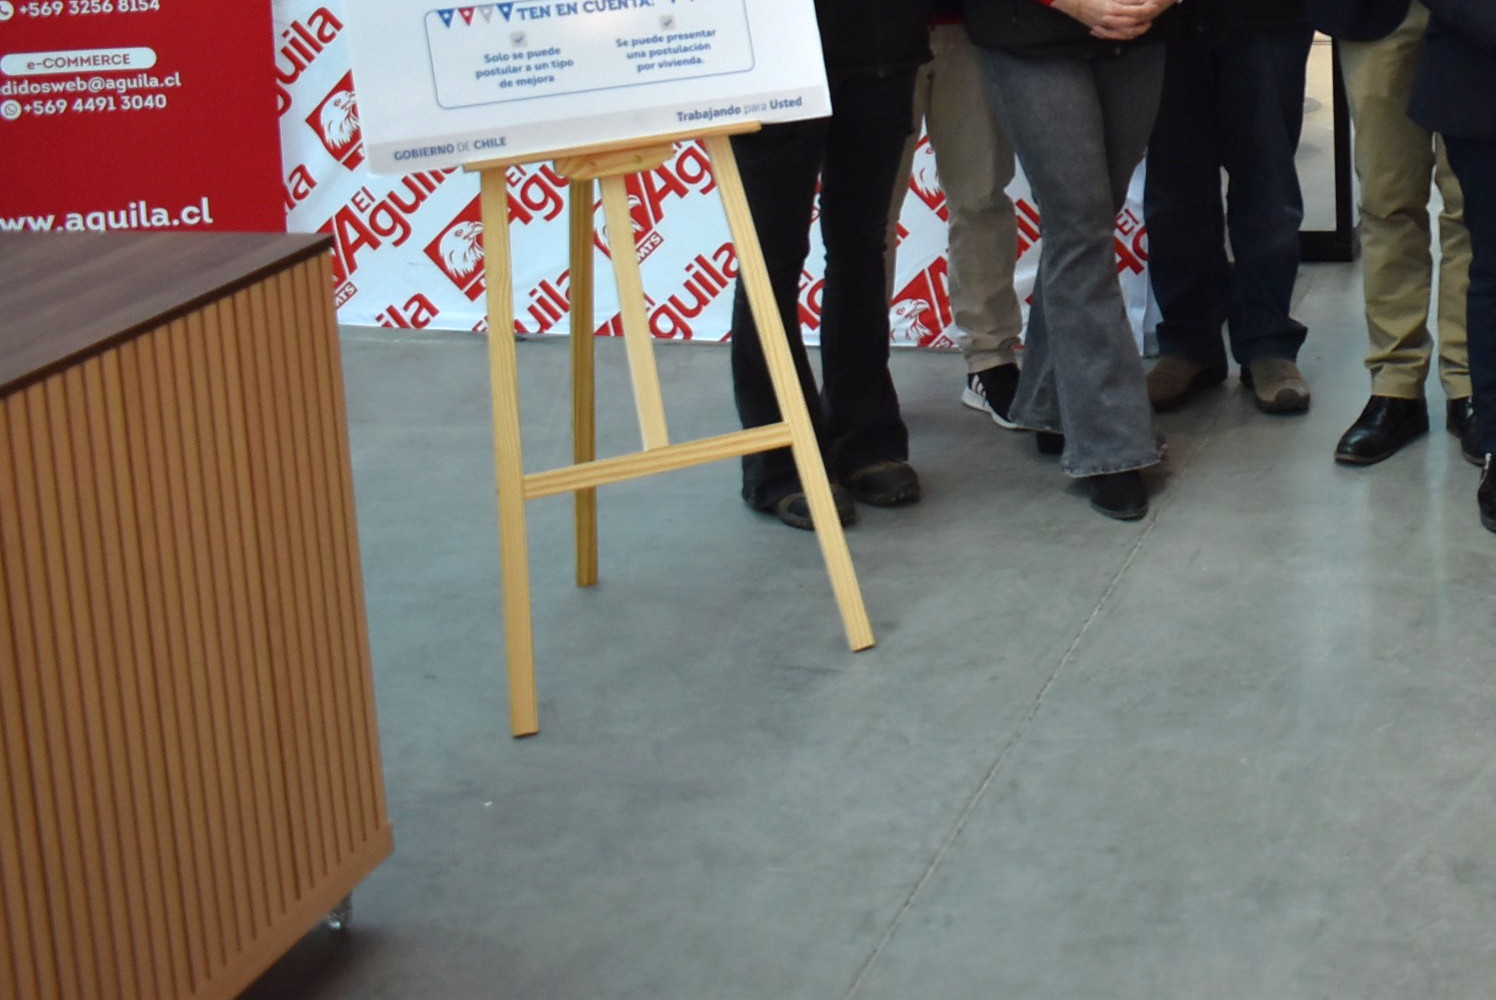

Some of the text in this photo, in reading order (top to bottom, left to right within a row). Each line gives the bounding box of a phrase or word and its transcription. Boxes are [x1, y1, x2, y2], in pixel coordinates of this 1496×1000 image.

[20, 1, 63, 16] +569
[516, 4, 552, 21] TEN
[554, 1, 579, 17] EN
[27, 53, 131, 69] e-COMMERCE
[24, 94, 167, 114] +569 4491 3040
[392, 136, 508, 161] GOBIERNO DE CHILE
